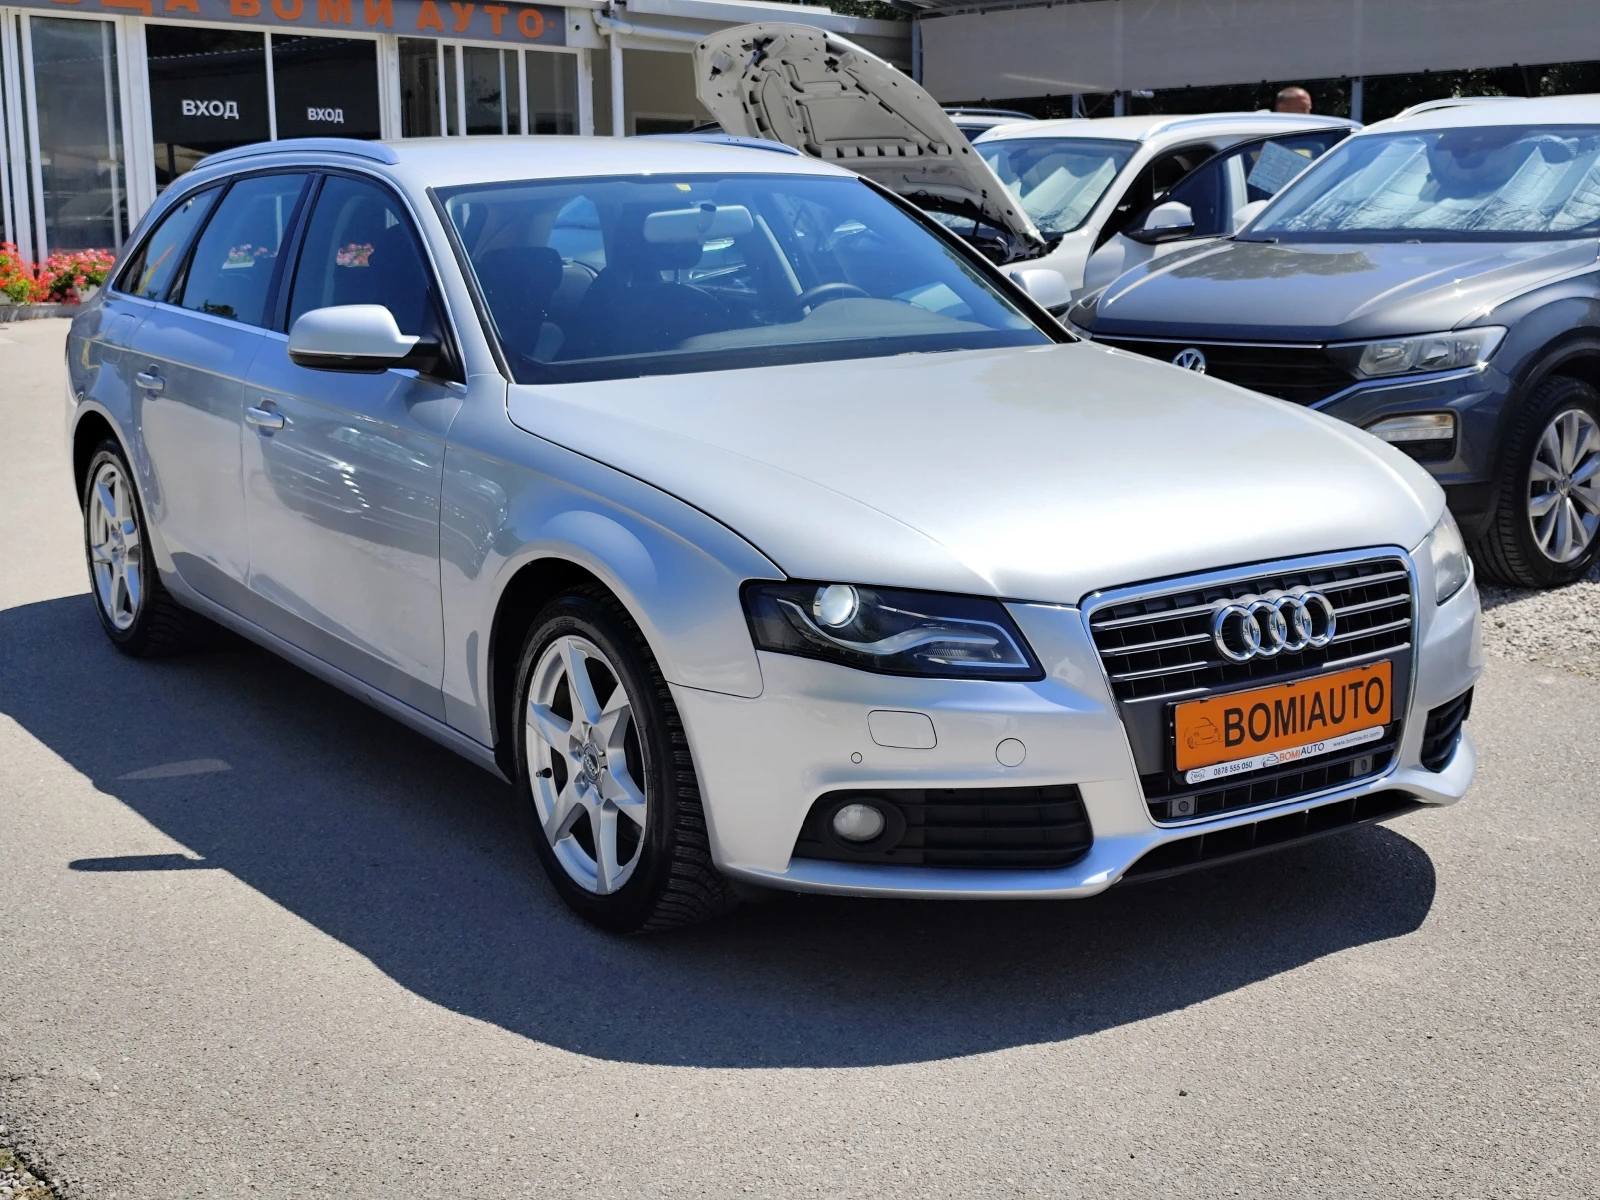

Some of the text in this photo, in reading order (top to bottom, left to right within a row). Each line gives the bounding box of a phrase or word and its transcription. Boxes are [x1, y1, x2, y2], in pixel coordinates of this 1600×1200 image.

[415, 0, 545, 39] АУТО
[181, 99, 240, 120] ВХОД
[307, 107, 345, 124] ВХОД
[1224, 676, 1385, 748] BOMIAUTO
[1229, 763, 1241, 773] 555
[1241, 760, 1253, 770] 050
